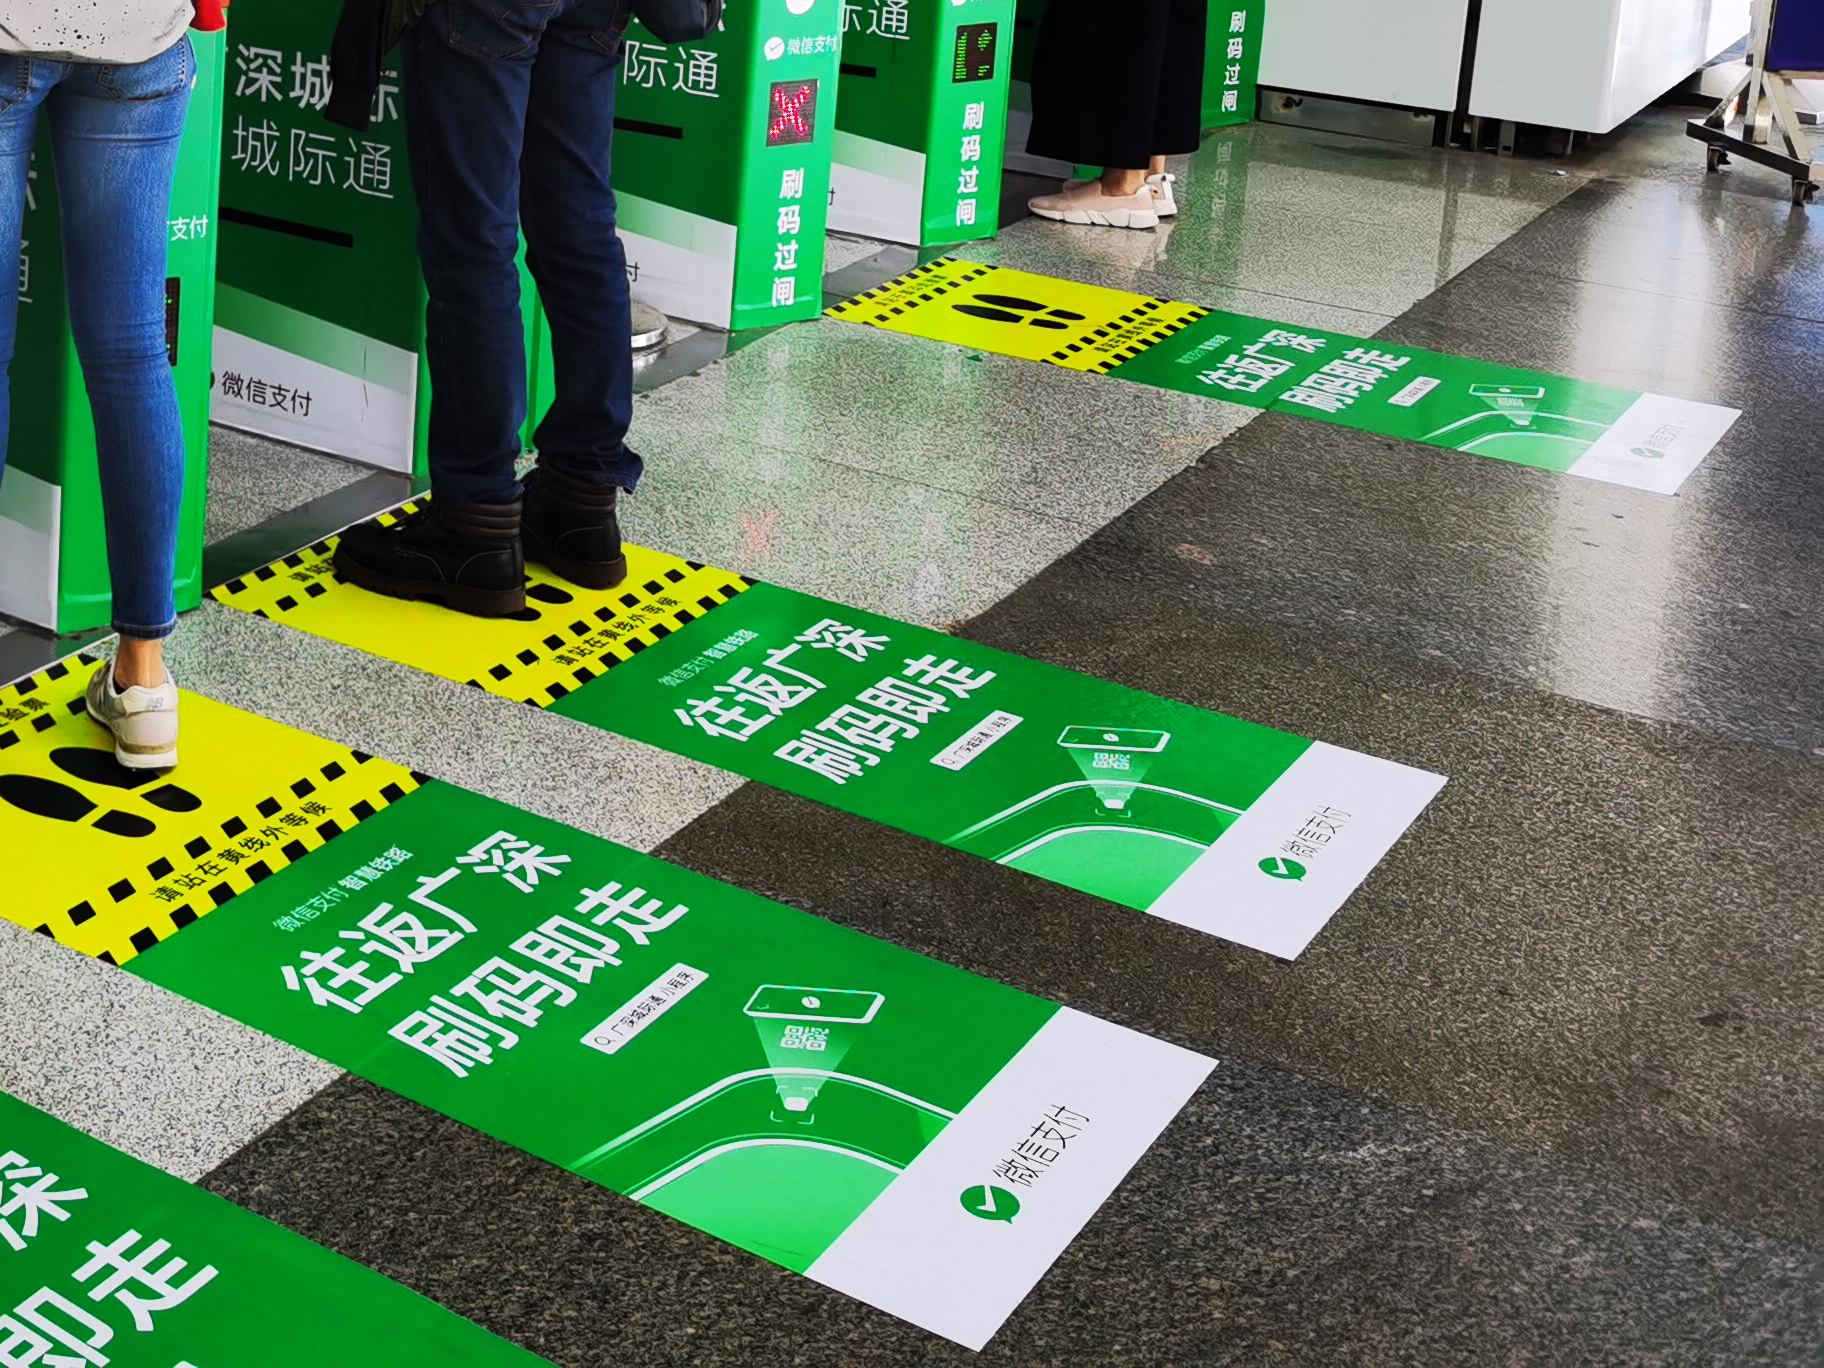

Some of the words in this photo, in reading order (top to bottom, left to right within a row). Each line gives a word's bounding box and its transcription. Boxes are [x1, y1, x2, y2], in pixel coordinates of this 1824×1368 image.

[623, 39, 719, 98] 际通
[787, 35, 839, 56] 微信支付
[231, 115, 394, 199] 城际通
[956, 101, 985, 227] 刷码过闸
[167, 214, 209, 242] 支付
[771, 167, 805, 308] 刷码过闸
[222, 370, 313, 417] 微信支付
[1195, 329, 1327, 393] 往返广深
[1279, 347, 1412, 414] 刷码即走
[673, 617, 891, 742] 往返广深
[773, 653, 997, 785] 刷码即走
[149, 799, 333, 904] 请站在黄线外等候
[1280, 804, 1352, 860] 微信支付
[280, 829, 573, 1015] 往返广深
[387, 880, 690, 1079] 刷码即走
[993, 1103, 1090, 1189] 微信支付
